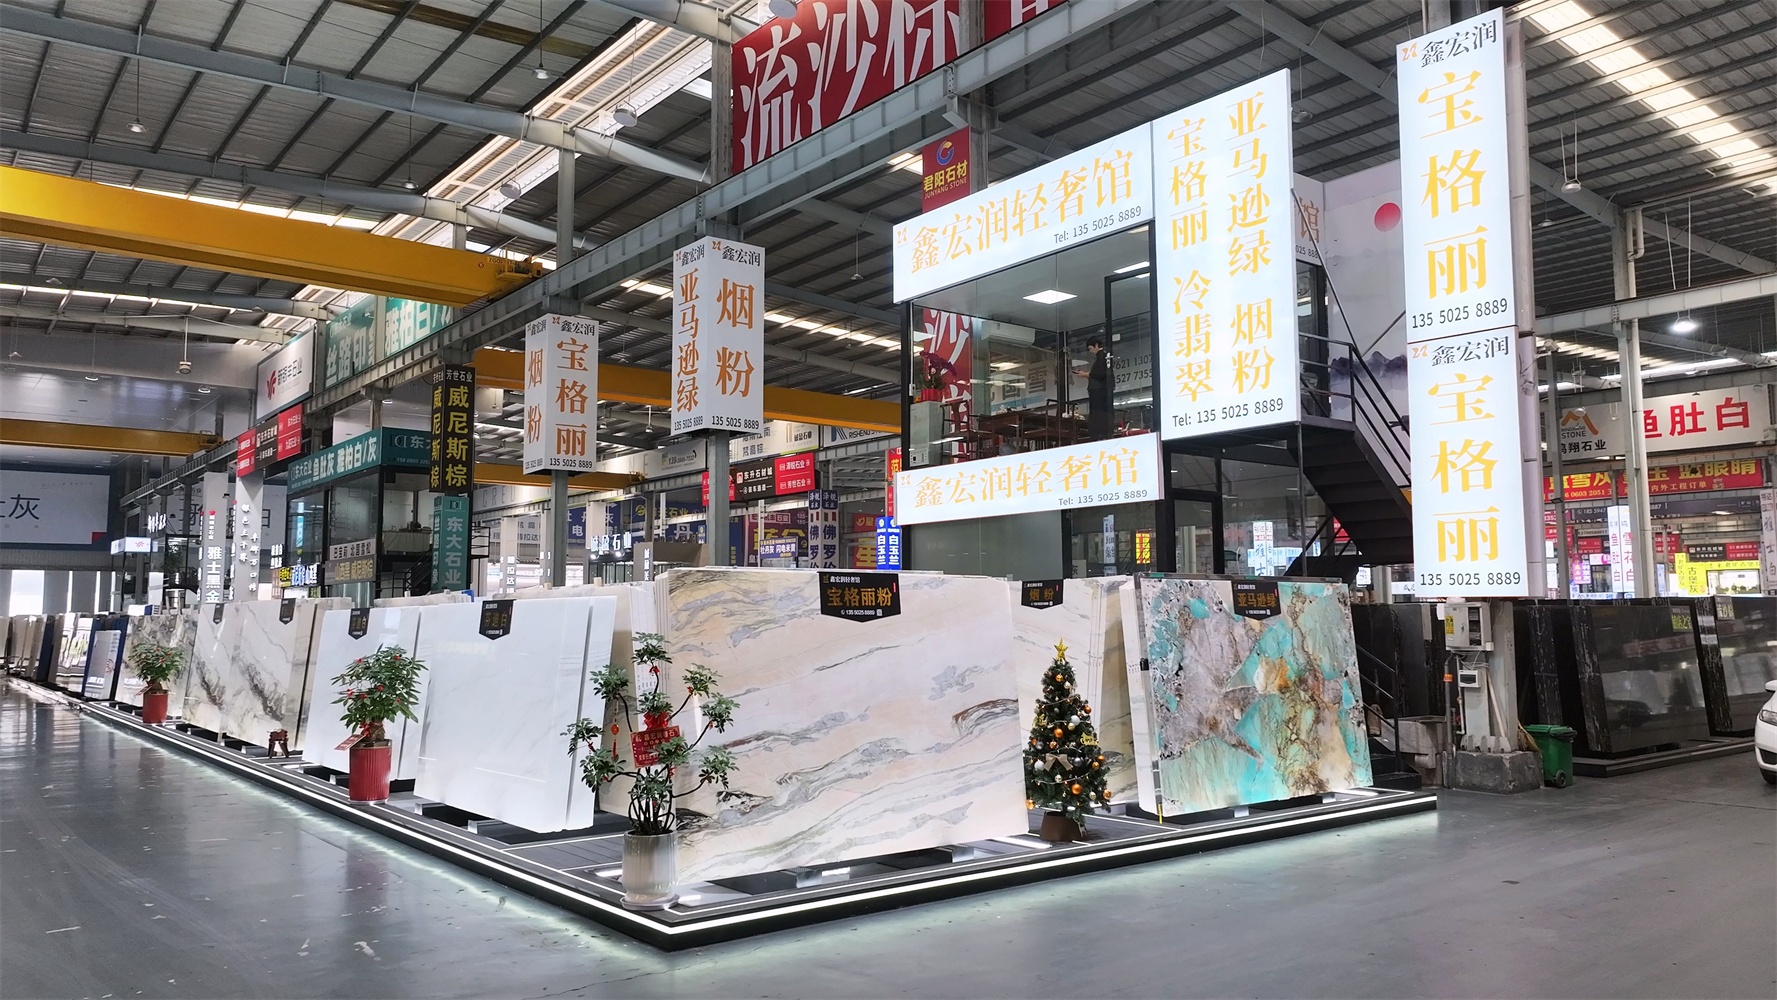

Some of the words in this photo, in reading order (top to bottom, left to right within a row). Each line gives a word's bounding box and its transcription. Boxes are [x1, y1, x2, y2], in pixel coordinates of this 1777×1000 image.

[1421, 19, 1497, 68] 鑫宏润
[924, 159, 968, 192] 君阳石材
[924, 184, 949, 200] JUNYANG
[949, 177, 968, 190] STONE
[1168, 117, 1208, 250] 宝格丽
[1225, 91, 1272, 277] 亚马逊绿
[1418, 70, 1488, 299] 宝格丽
[911, 149, 1134, 273] 鑫宏润轻奢馆
[1054, 231, 1069, 244] Tel:
[1073, 224, 1089, 238] 135
[1092, 215, 1115, 232] 5025
[1118, 205, 1142, 223] 8889
[681, 244, 705, 266] 鑫宏润
[722, 245, 760, 266] 鑫宏润
[530, 320, 546, 336] 鑫宏润
[1412, 313, 1433, 328] 135
[1439, 305, 1470, 323] 5025
[1475, 298, 1508, 318] 8889
[560, 321, 595, 336] 鑫宏润
[676, 268, 699, 412] 亚马逊绿
[715, 278, 754, 397] 烟粉
[1173, 270, 1214, 402] 冷翡翠
[1230, 298, 1275, 394] 烟粉
[1432, 336, 1509, 366] 鑫宏润
[446, 369, 472, 382] 芳世石业
[1113, 373, 1131, 384] 527
[526, 348, 543, 444] 烟粉
[555, 337, 588, 456] 宝格丽
[674, 421, 682, 431] 135
[683, 418, 692, 430] 5025
[693, 415, 703, 427] 8889
[711, 415, 723, 425] 135
[725, 416, 742, 428] 5025
[743, 417, 759, 430] 8889
[1172, 413, 1191, 428] Tel:
[1197, 409, 1216, 424] 135
[1221, 403, 1249, 420] 5025
[1254, 397, 1284, 415] 8889
[430, 385, 442, 488] 威尼斯棕
[445, 385, 469, 487] 威尼斯棕
[1561, 430, 1586, 439] STONE
[295, 460, 312, 480] 东大石业
[313, 453, 334, 482] 鱼肚灰
[337, 437, 377, 473] 雅柏白/灰
[550, 458, 560, 467] 135
[562, 459, 576, 467] 5025
[578, 460, 593, 468] 8889
[743, 467, 772, 480] 东升石材城
[1428, 373, 1499, 562] 宝格丽
[914, 448, 1139, 508] 鑫宏润轻奢馆
[1651, 481, 1708, 492] 内外工程订单
[1058, 496, 1074, 506] Tel:
[1078, 495, 1094, 504] 135
[1097, 493, 1120, 502] 5025
[1124, 489, 1147, 499] 8889
[445, 516, 463, 584] 东大石业
[877, 535, 885, 565] 白玉兰
[889, 535, 899, 565] 白玉兰
[206, 546, 222, 603] 雅士黑金
[351, 558, 373, 580] 威尼斯棕
[1419, 573, 1442, 587] 135
[1449, 573, 1481, 586] 5025
[1487, 571, 1521, 585] 8889
[827, 587, 892, 606] 宝格丽粉
[1237, 593, 1276, 607] 亚马逊绿
